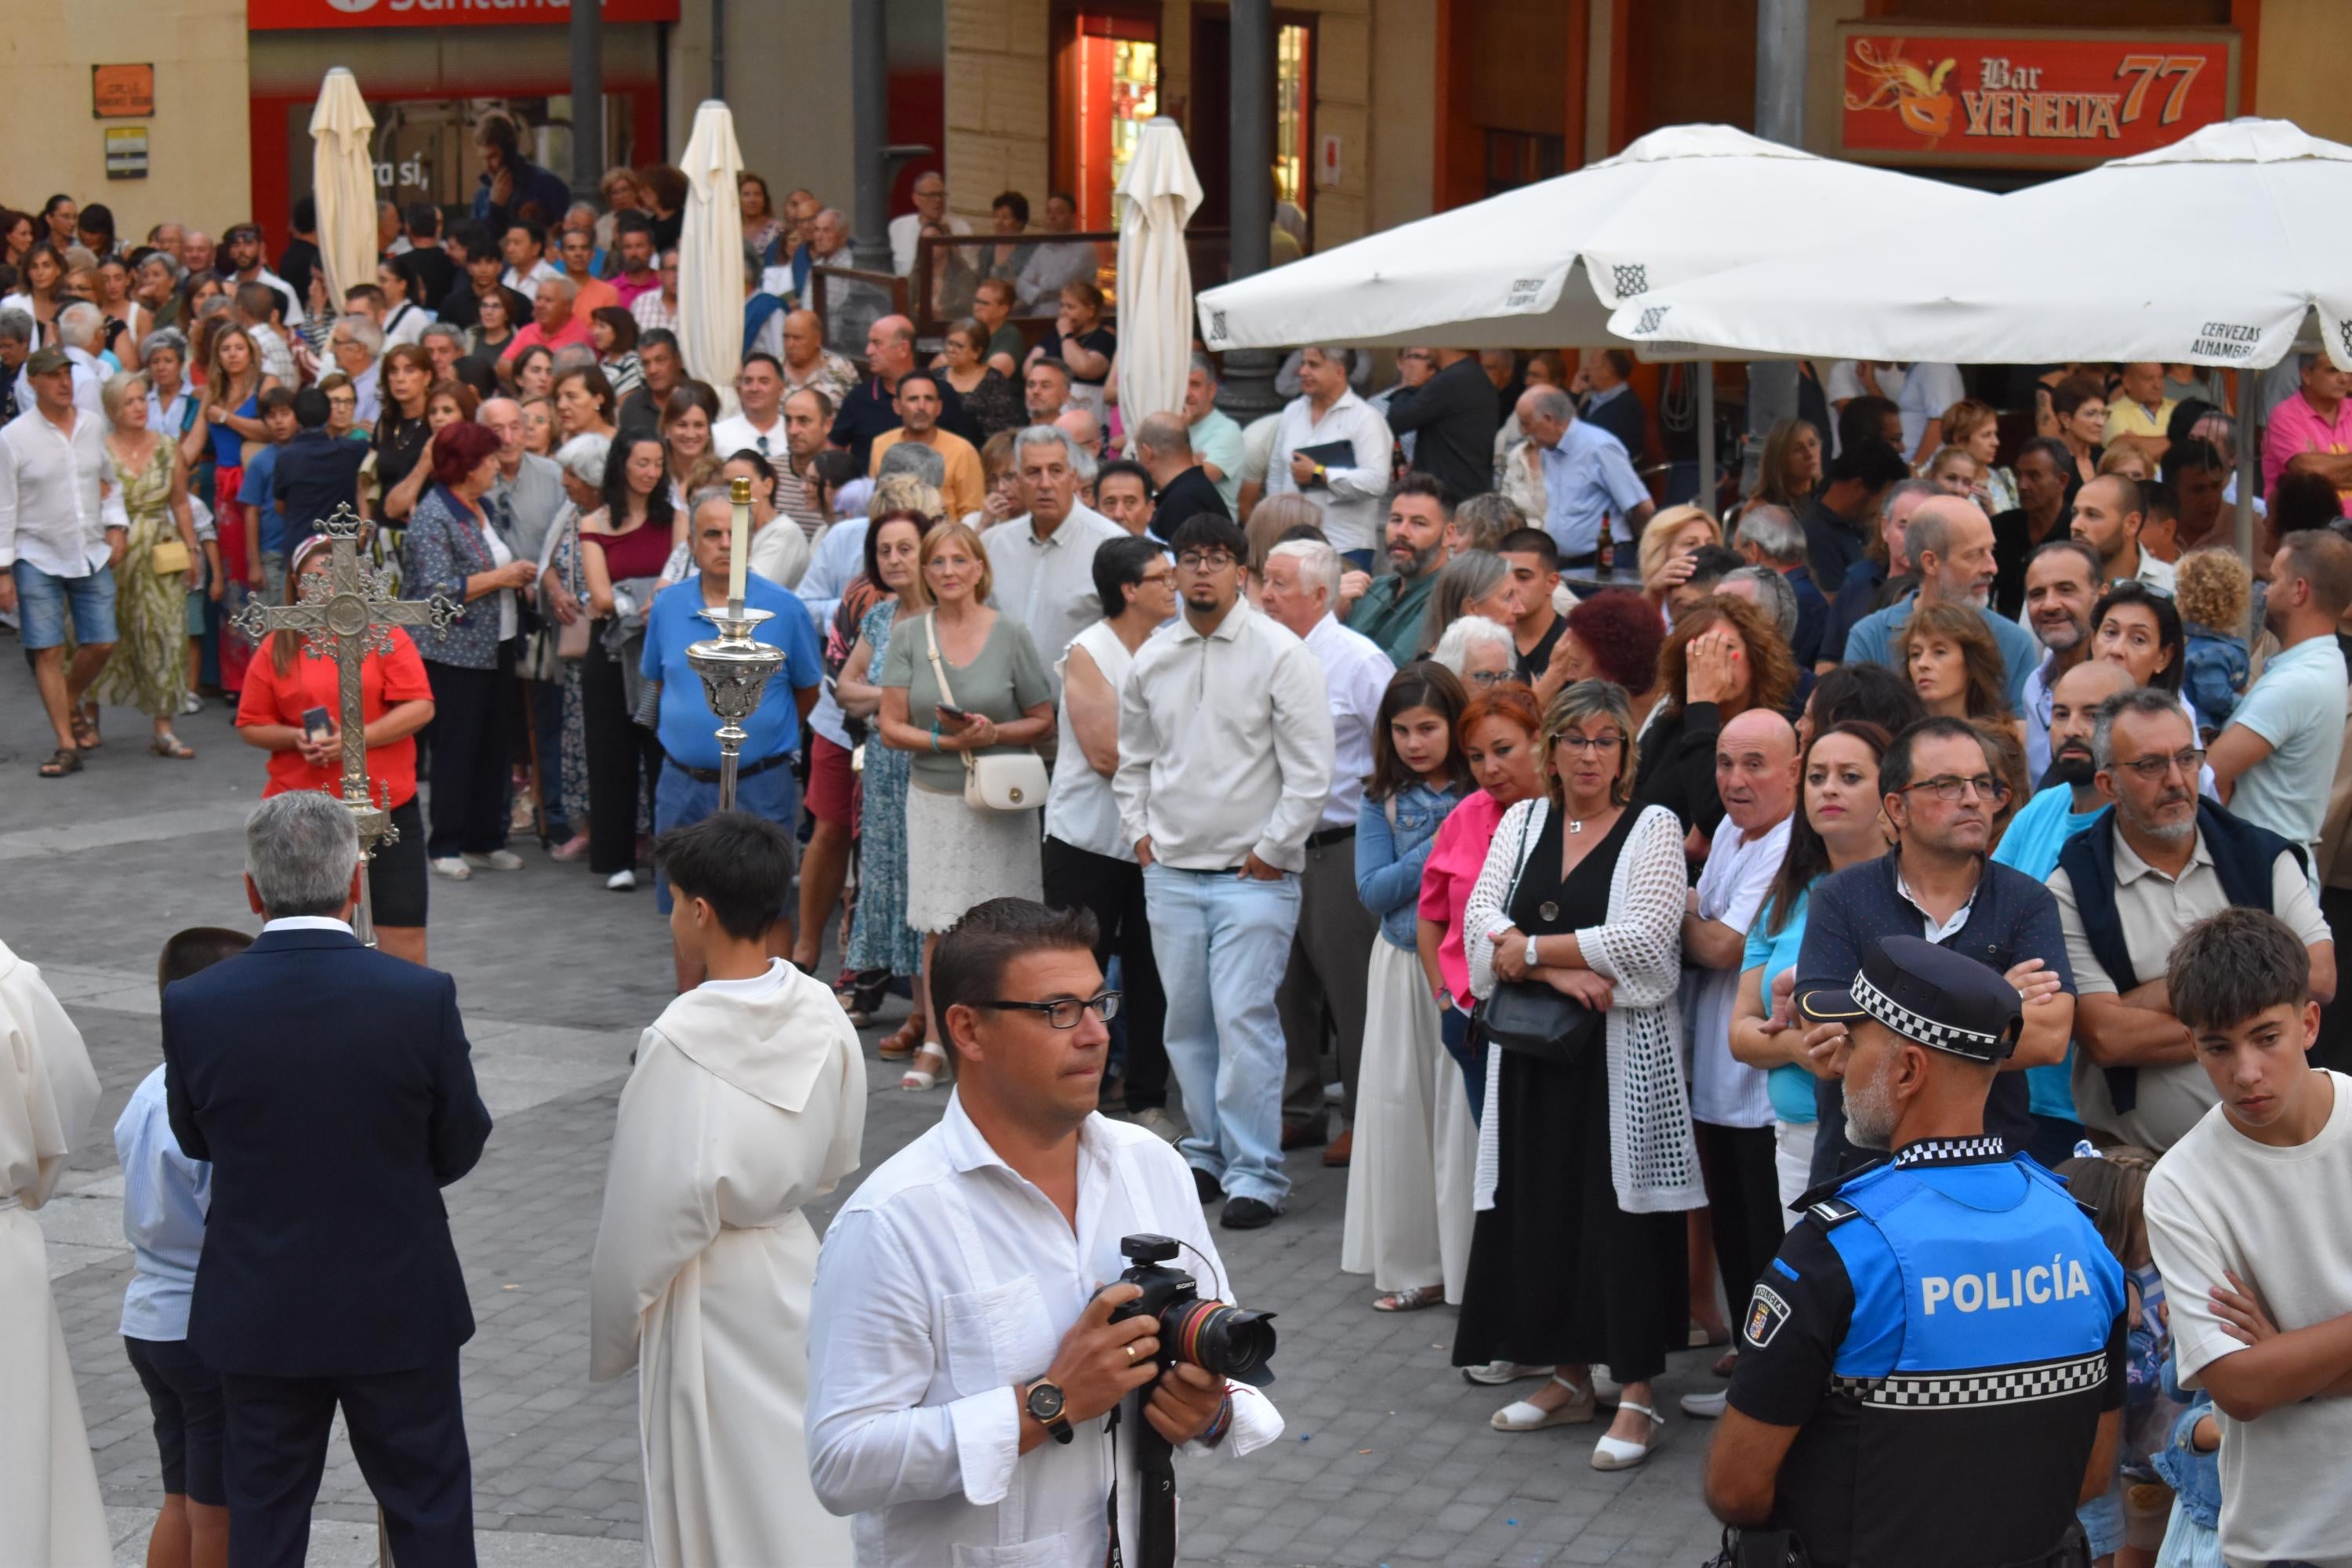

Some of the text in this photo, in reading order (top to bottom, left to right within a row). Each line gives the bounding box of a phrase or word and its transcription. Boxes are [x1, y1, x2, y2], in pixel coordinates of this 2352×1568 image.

[1962, 54, 2207, 139] VENECIA 77
[1979, 57, 2043, 90] Bar
[2201, 321, 2262, 343] CERVEZAS
[1922, 1253, 2091, 1316] POLICÍA
